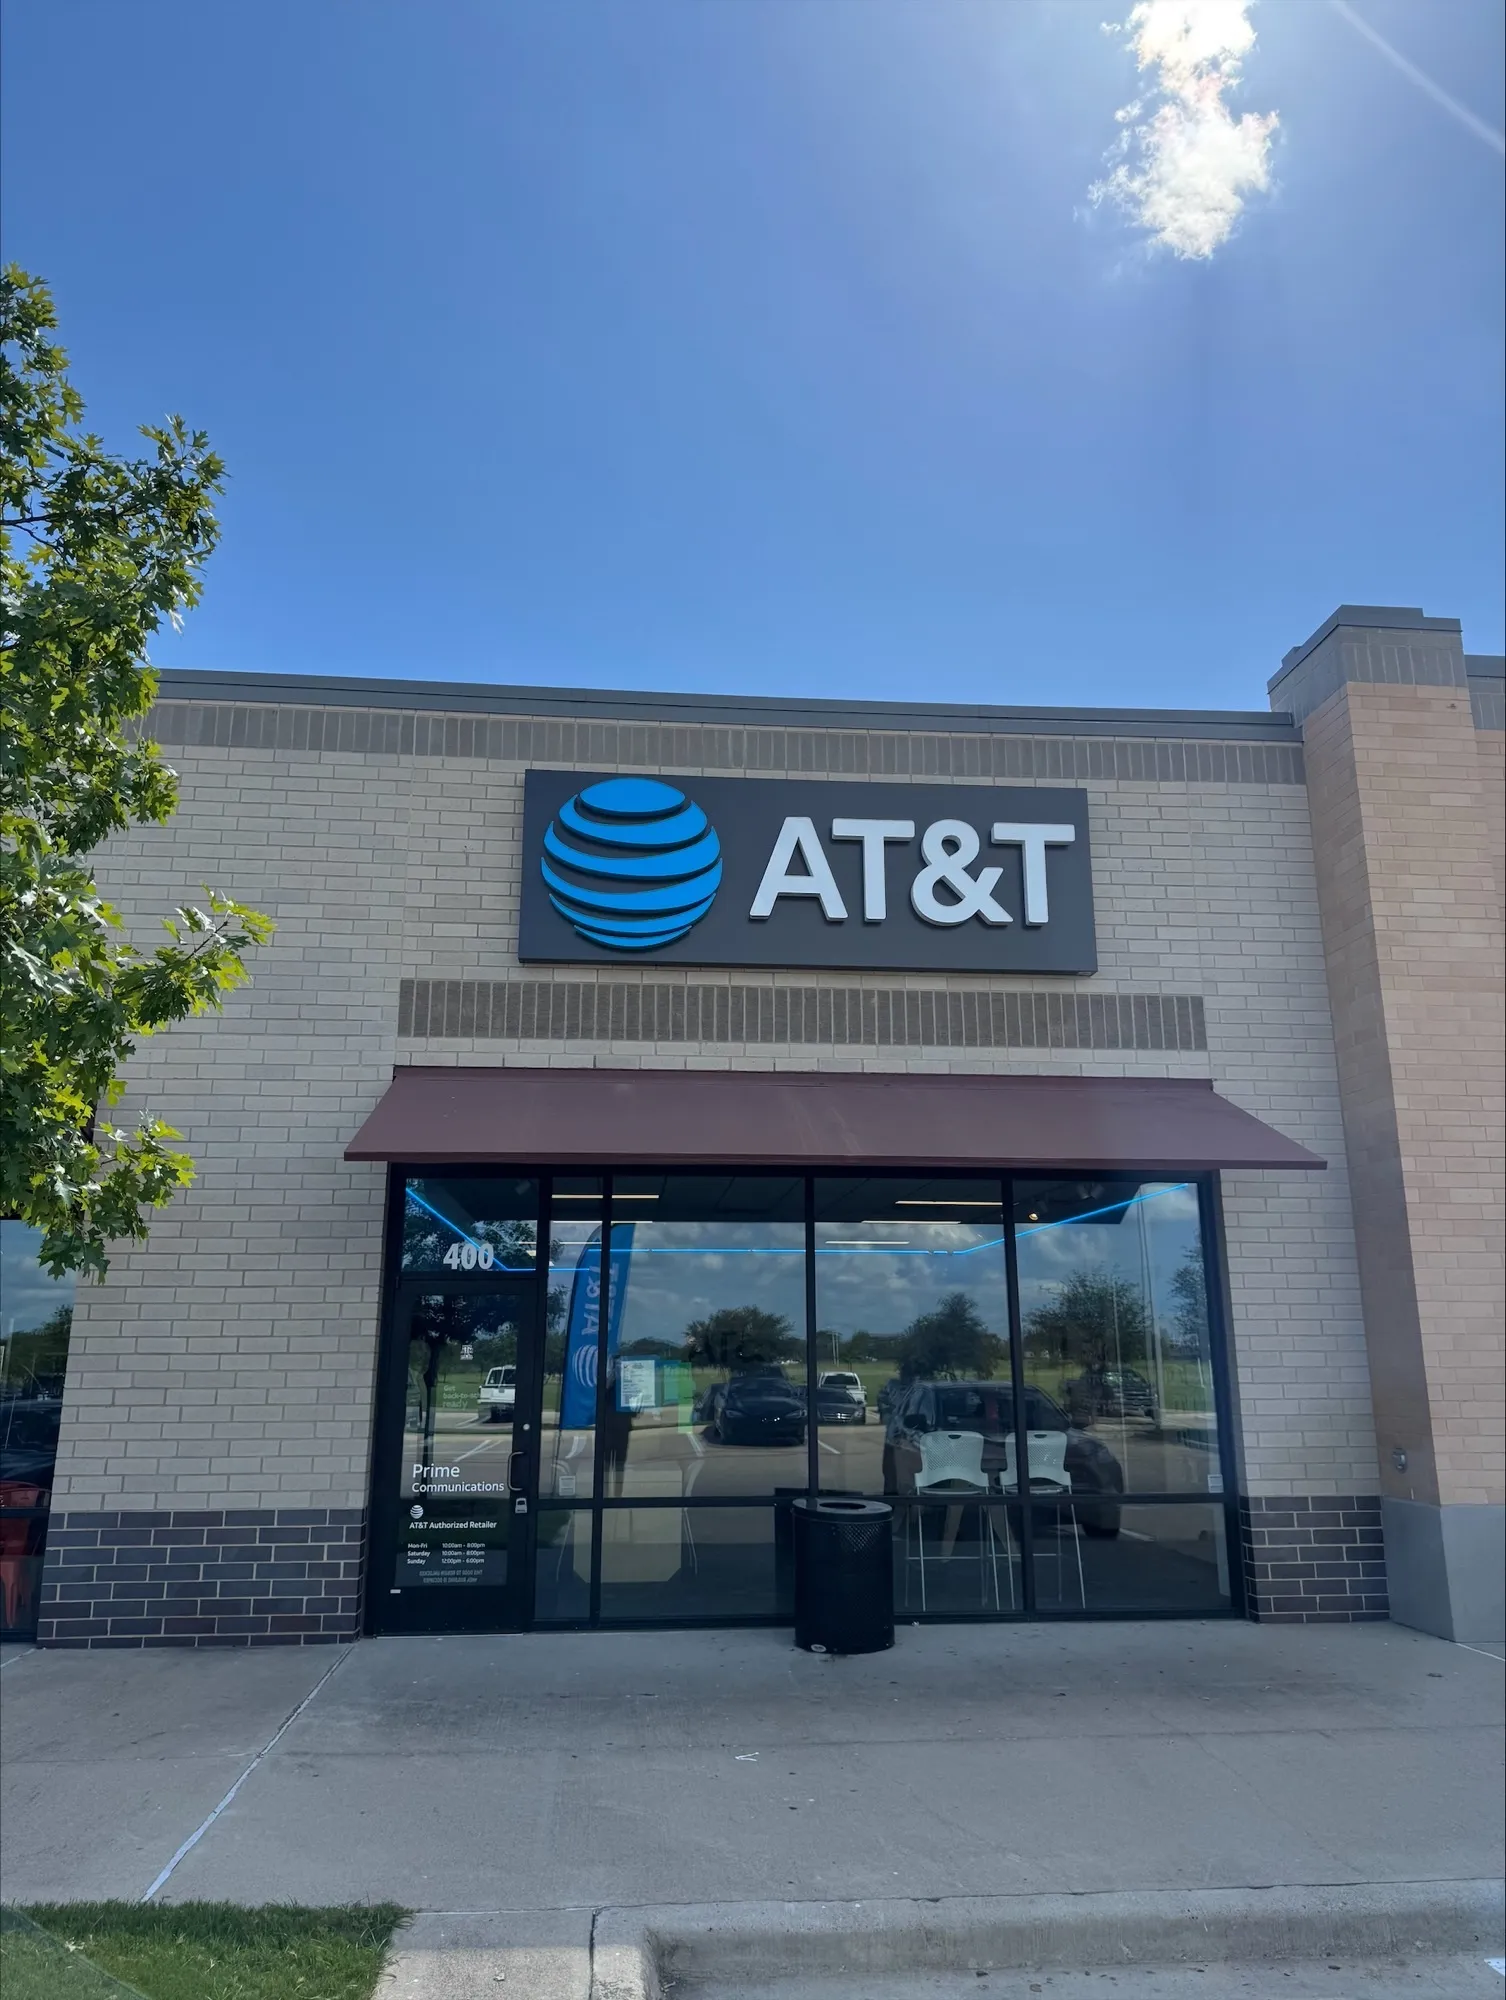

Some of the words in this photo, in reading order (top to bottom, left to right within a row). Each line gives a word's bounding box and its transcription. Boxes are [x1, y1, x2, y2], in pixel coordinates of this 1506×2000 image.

[748, 816, 1076, 927] AT&T
[443, 1243, 494, 1270] 400
[412, 1463, 460, 1478] Prime
[412, 1482, 504, 1493] Communications
[409, 1521, 428, 1529] AT&T
